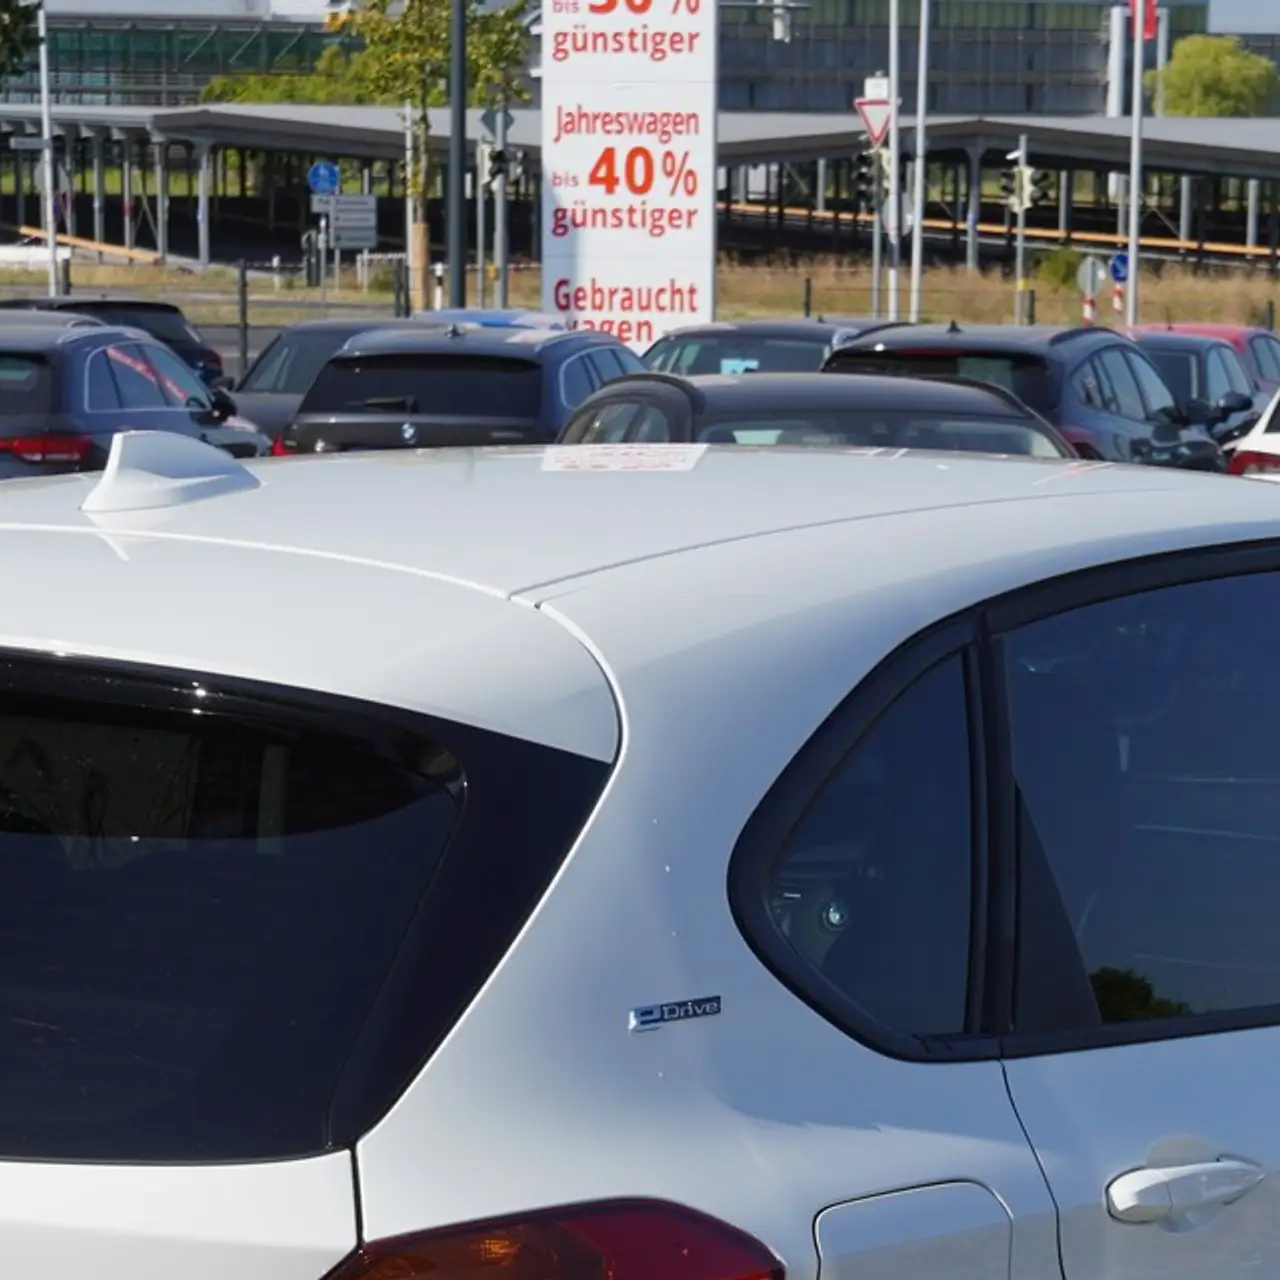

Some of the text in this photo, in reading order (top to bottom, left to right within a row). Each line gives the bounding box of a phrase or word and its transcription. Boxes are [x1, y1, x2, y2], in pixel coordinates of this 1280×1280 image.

[552, 24, 700, 62] günstiger
[553, 104, 699, 144] Jahreswagen
[552, 171, 580, 187] bis
[552, 200, 698, 237] günstiger
[554, 278, 698, 313] Gebraucht
